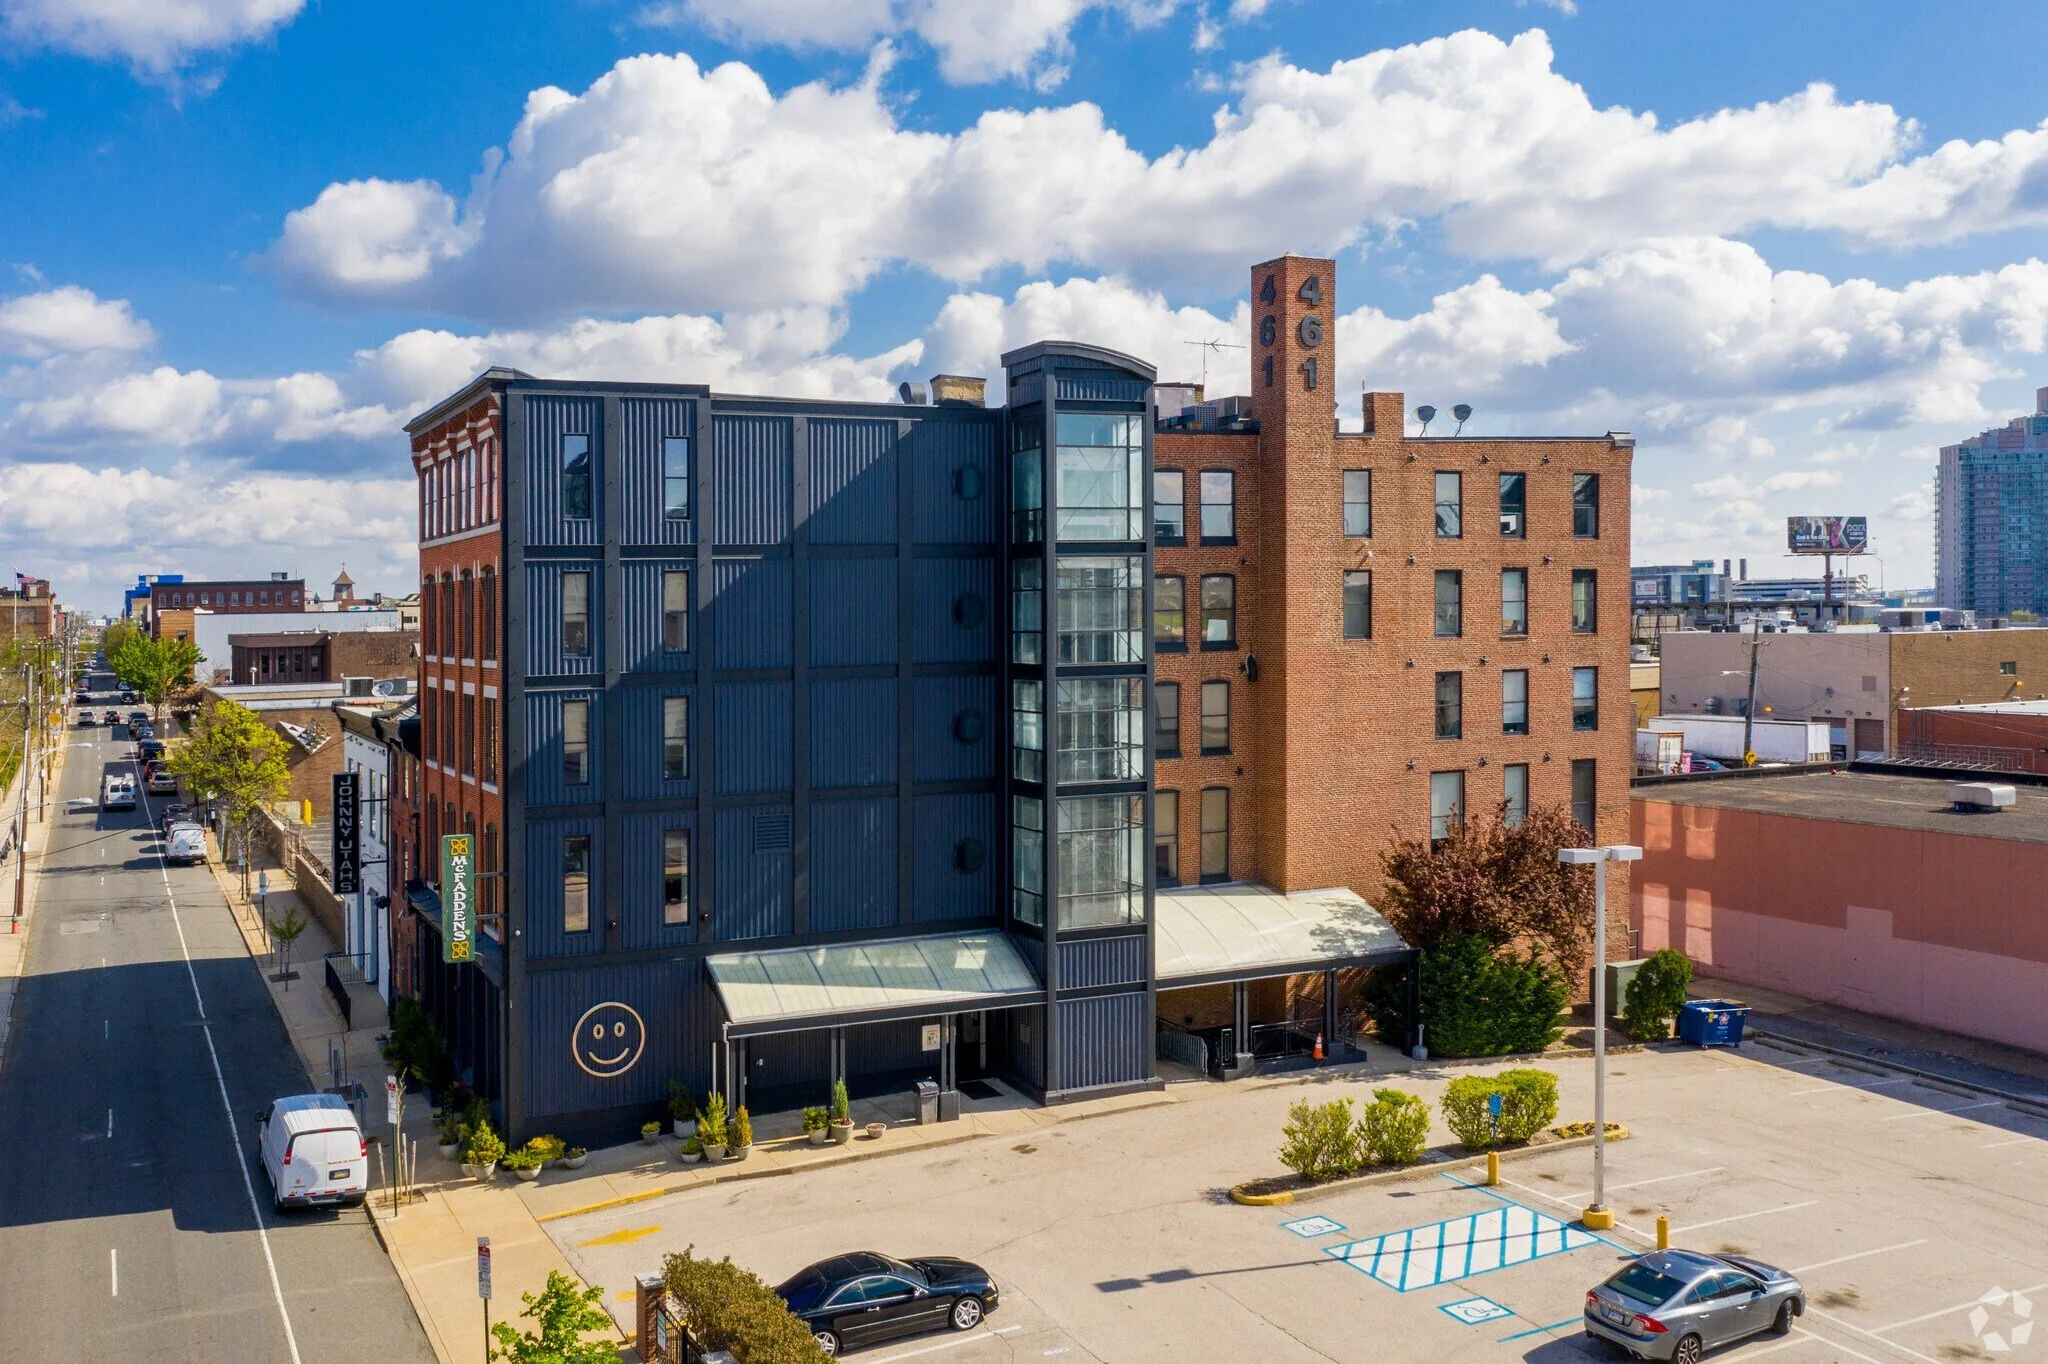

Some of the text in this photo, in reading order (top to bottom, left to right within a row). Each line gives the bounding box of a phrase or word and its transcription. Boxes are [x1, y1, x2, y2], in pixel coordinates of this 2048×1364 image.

[1259, 274, 1276, 388] 461
[1299, 273, 1323, 389] 461
[339, 775, 352, 837] JOHNNY
